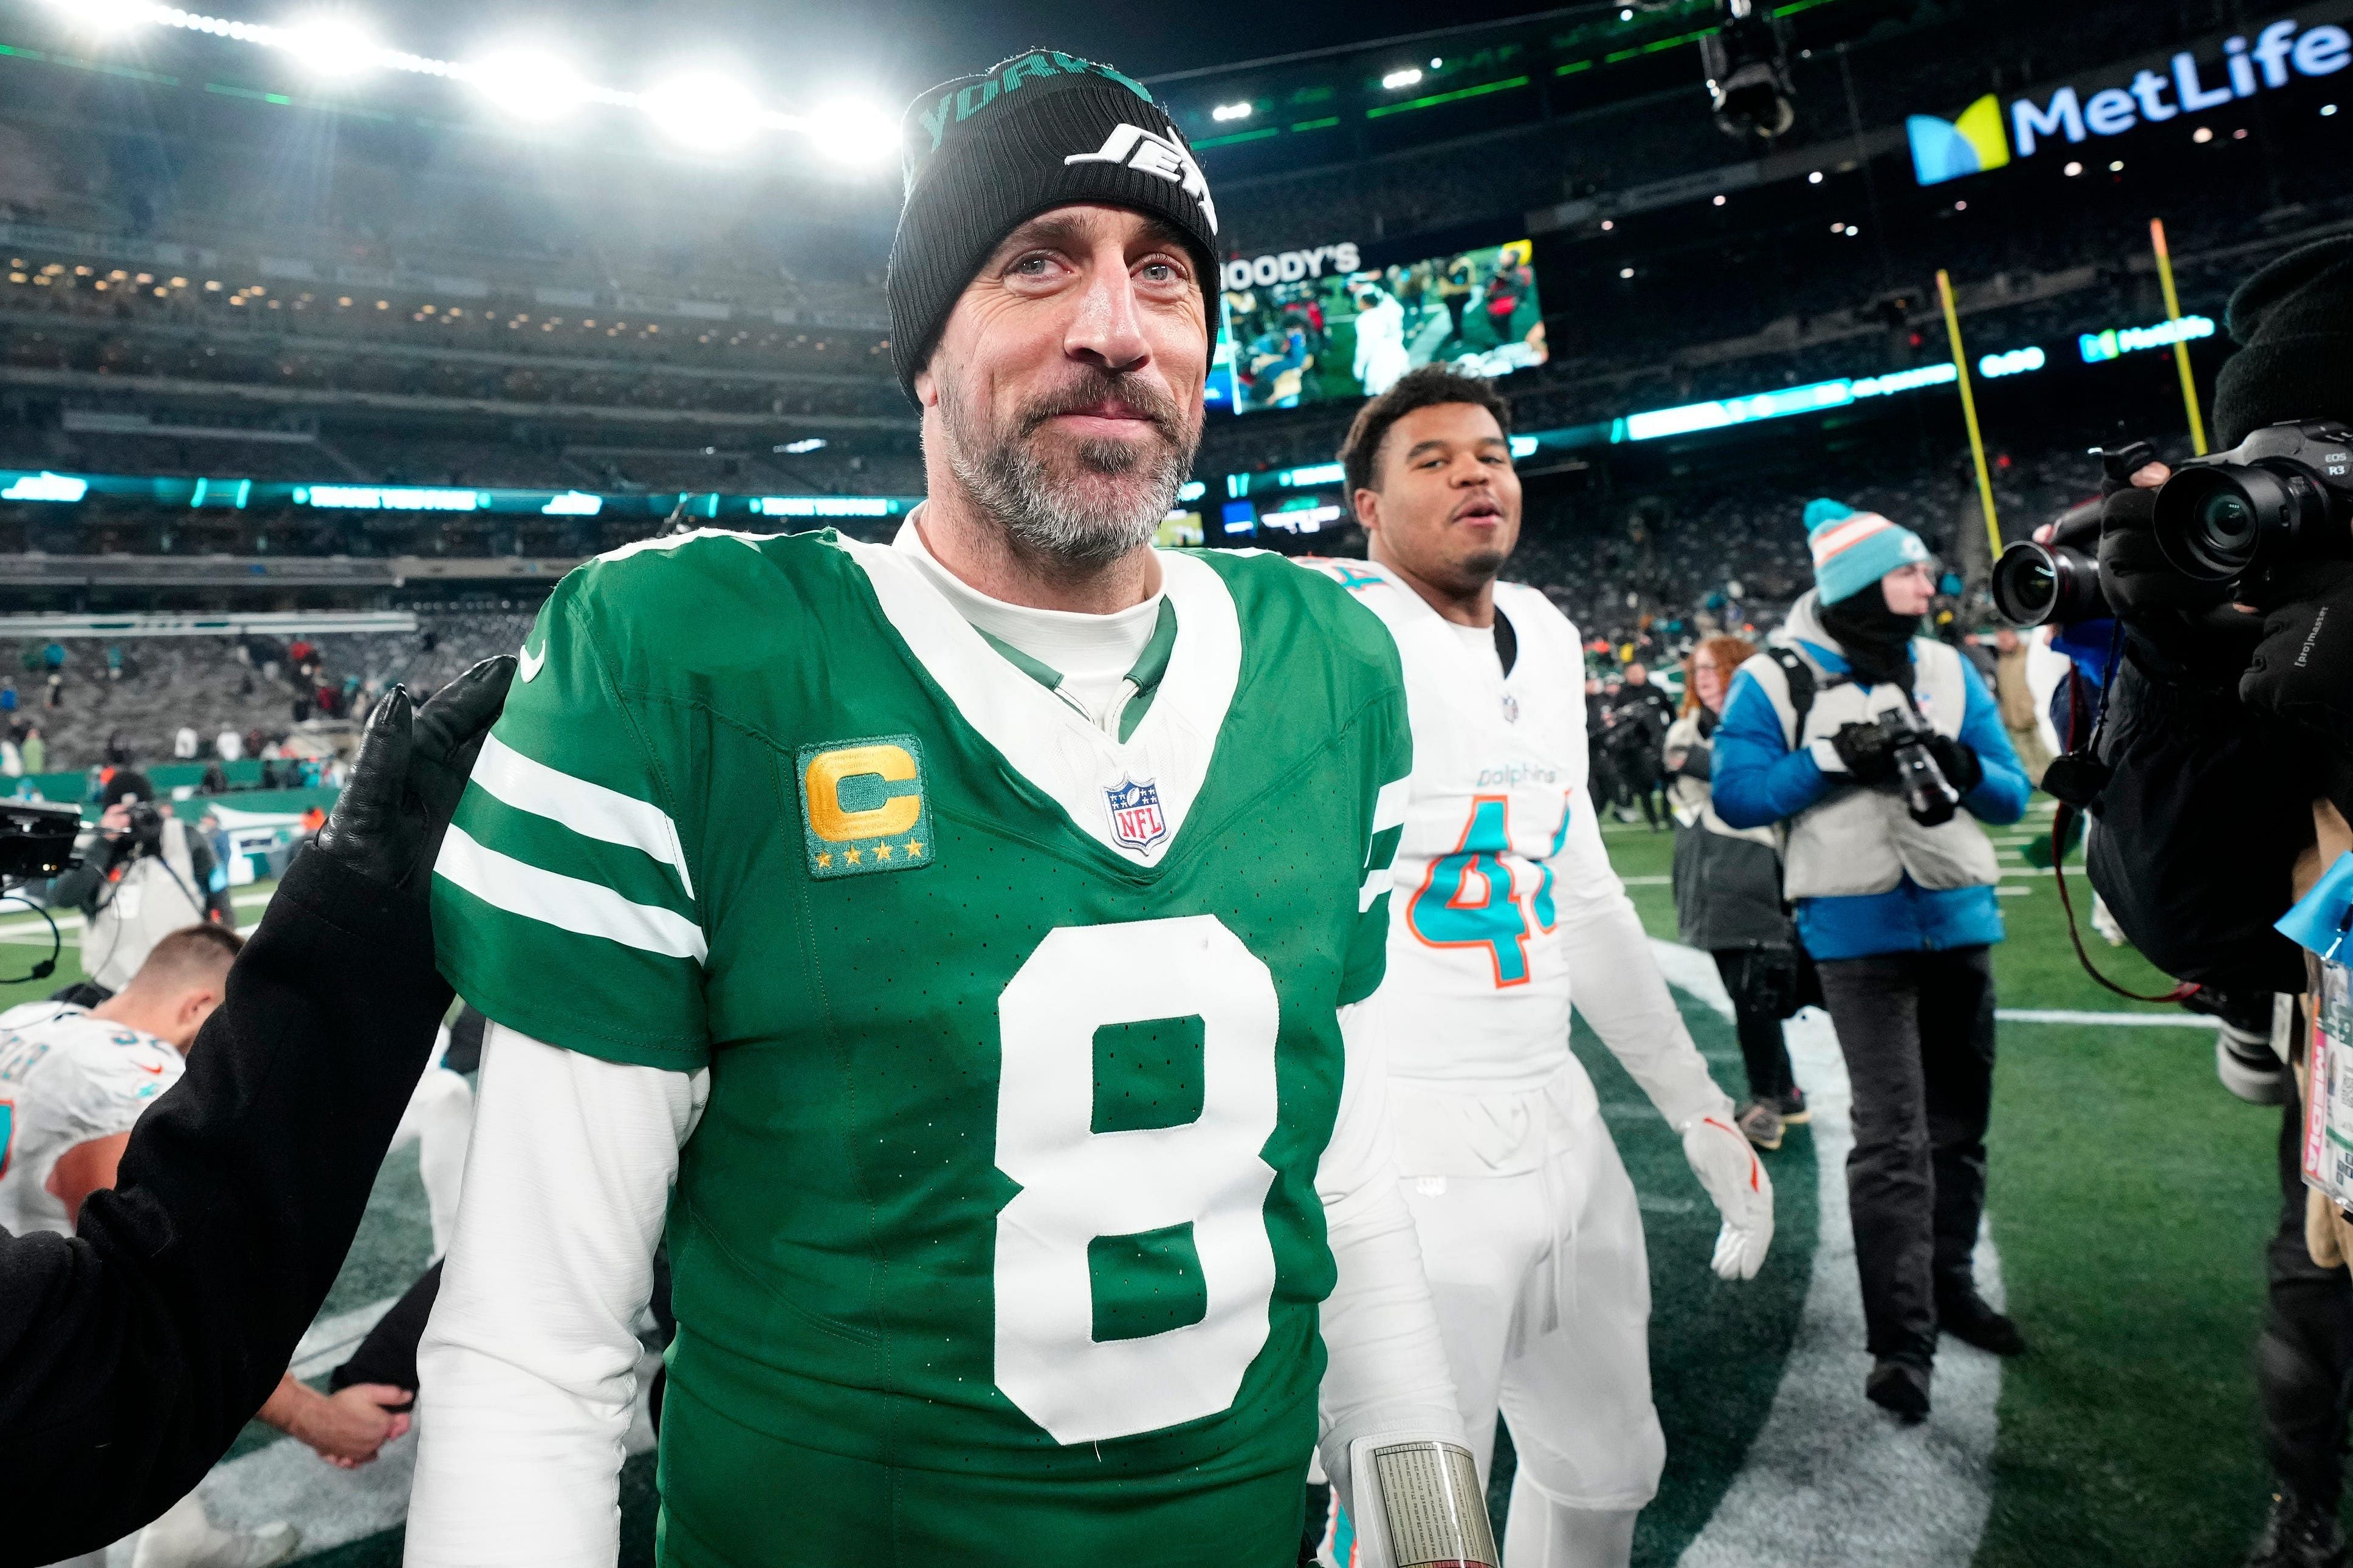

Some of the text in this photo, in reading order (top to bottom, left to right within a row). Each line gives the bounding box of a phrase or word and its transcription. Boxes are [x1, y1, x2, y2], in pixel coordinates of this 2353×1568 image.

[2010, 19, 2352, 157] MetLife
[2325, 453, 2346, 463] EOS
[2329, 465, 2345, 476] R3
[805, 744, 921, 843] C
[1477, 763, 1556, 789] Dolphins
[1117, 807, 1162, 840] NFL
[2306, 1045, 2325, 1171] MEDIA
[994, 914, 1279, 1446] 8
